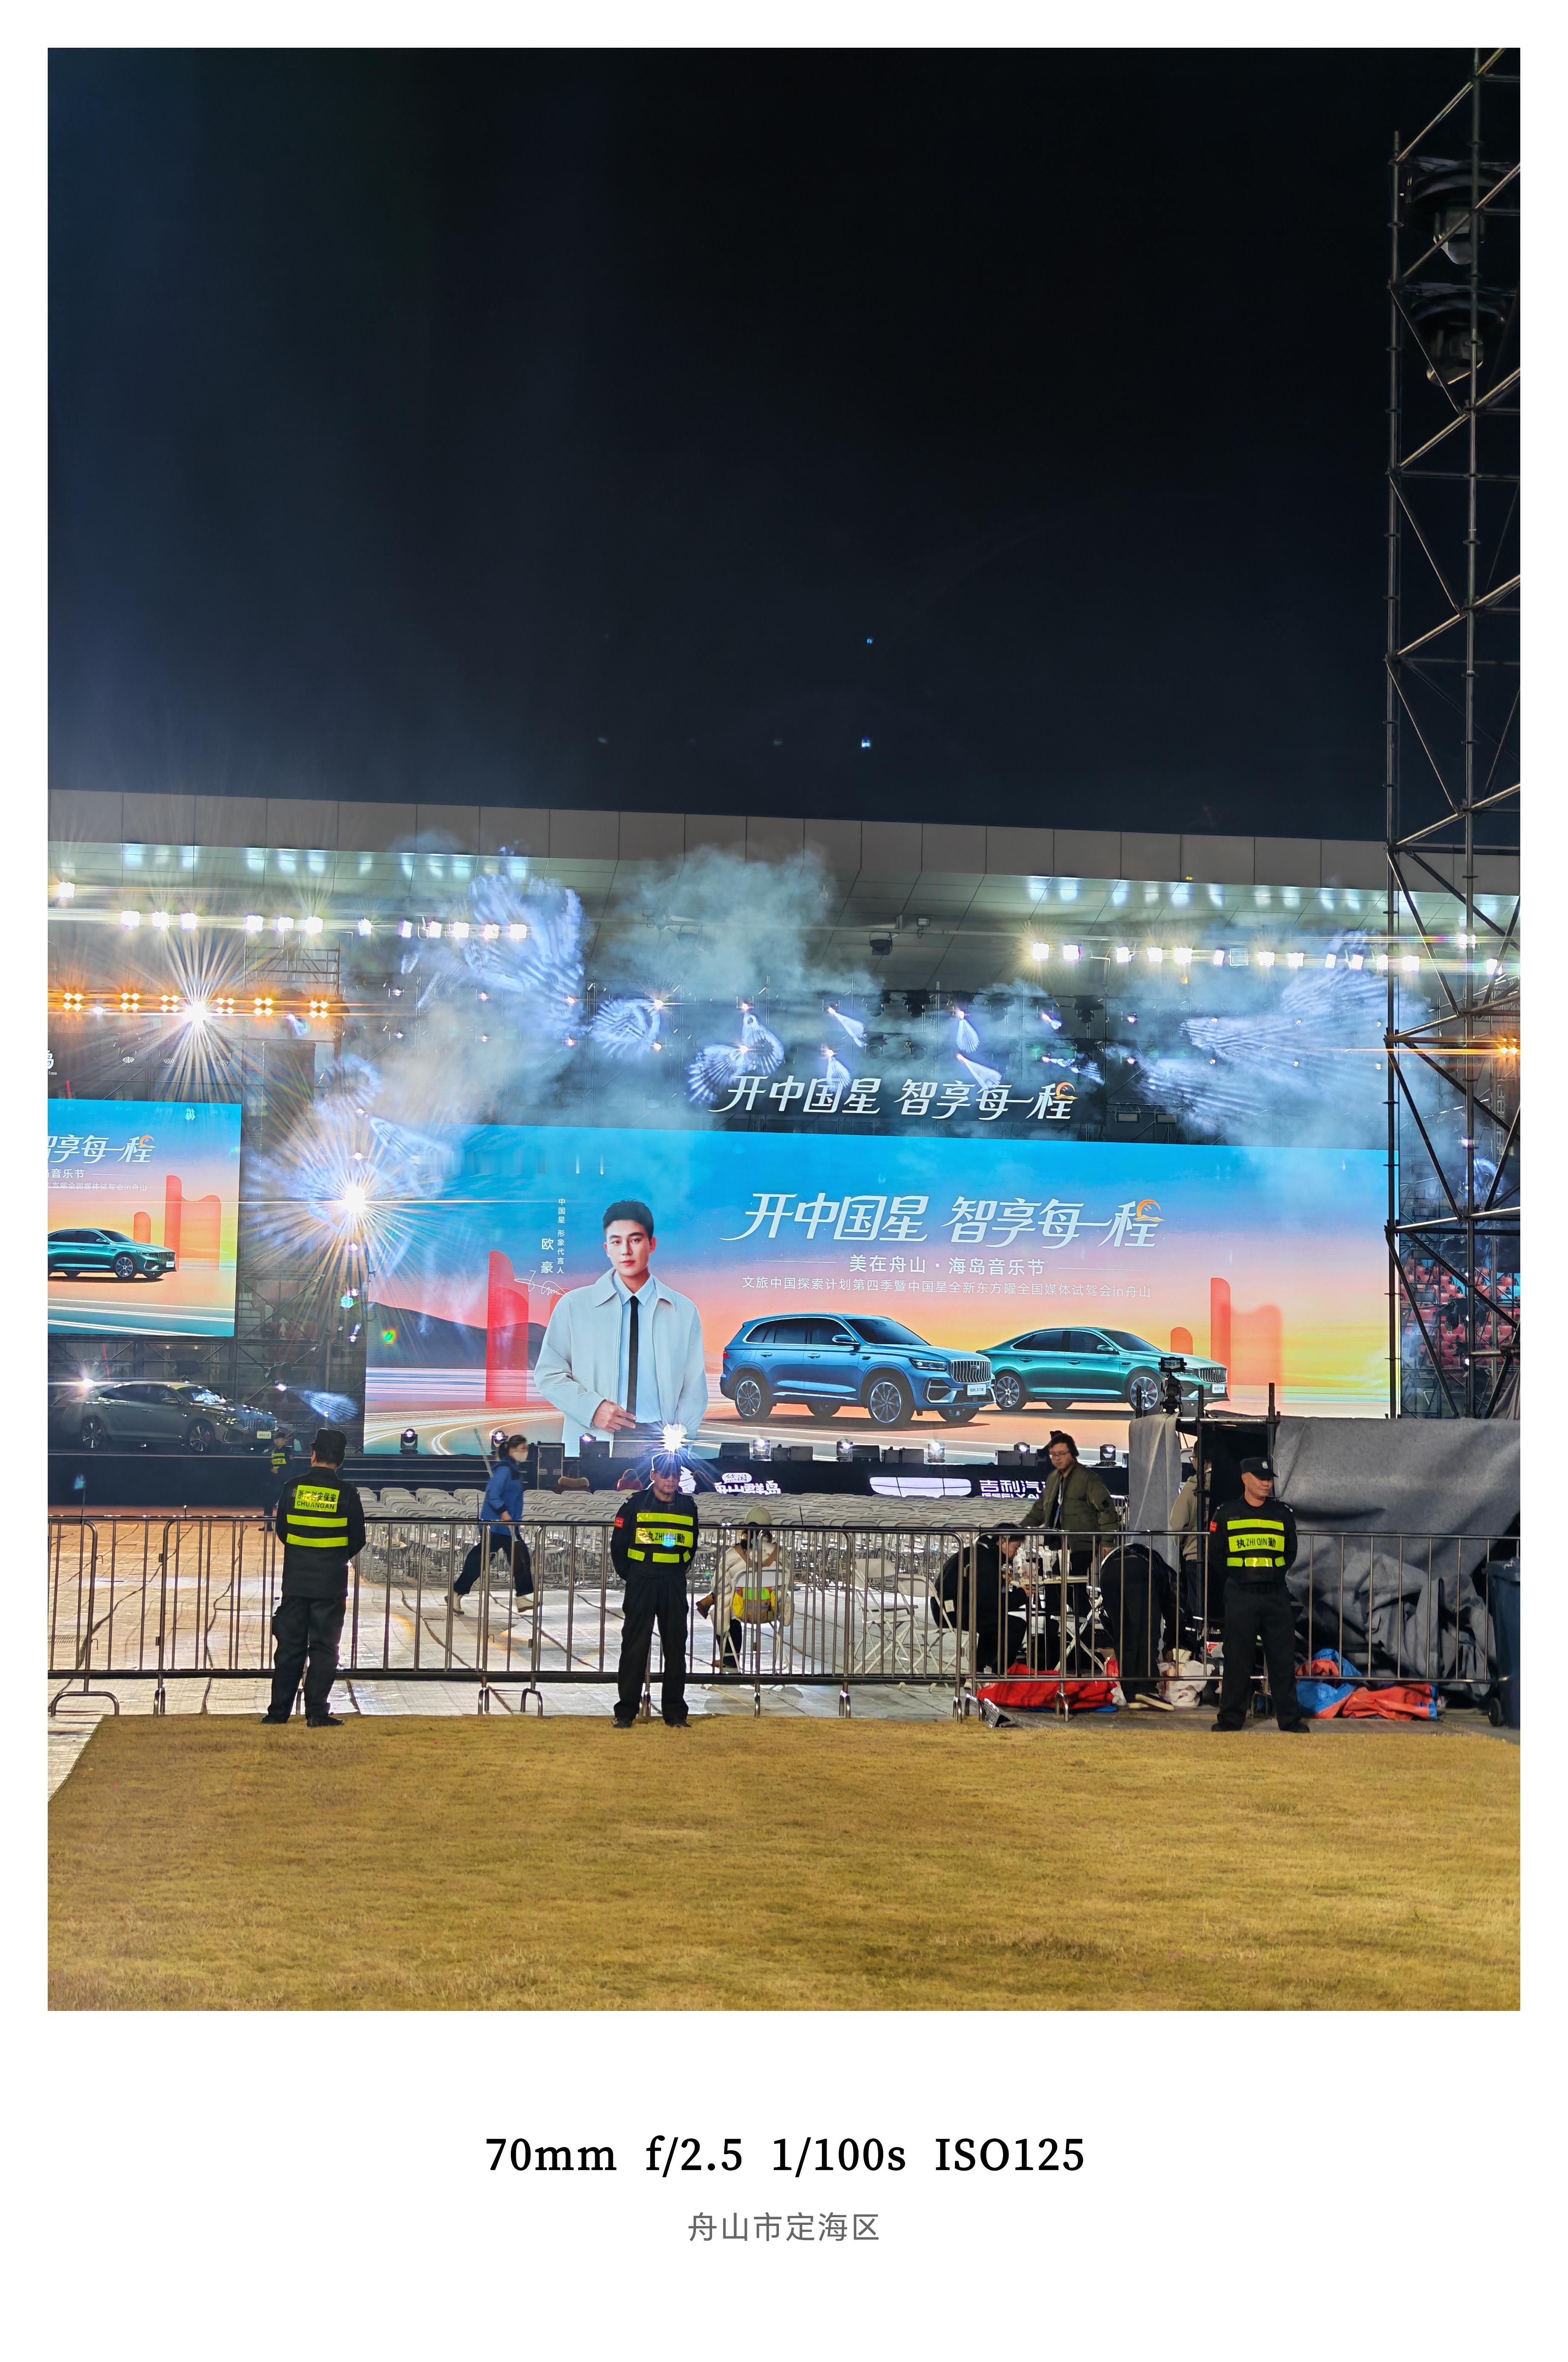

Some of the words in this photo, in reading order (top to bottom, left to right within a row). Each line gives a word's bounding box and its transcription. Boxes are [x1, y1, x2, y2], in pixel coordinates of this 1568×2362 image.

[709, 1075, 882, 1113] 开中国星
[894, 1078, 1079, 1120] 智享每一程
[48, 1169, 85, 1179] 音乐节
[720, 1193, 928, 1241] 开中国星
[941, 1196, 1164, 1249] 智享每一程
[556, 1230, 565, 1274] 形象代言人
[742, 1276, 1151, 1298] 文旅中国探索计划第四季暨中国星全新东方曜全国媒体试驾会in舟山
[715, 1480, 781, 1495] 舟山群岛
[297, 1501, 334, 1509] CHUANGAN
